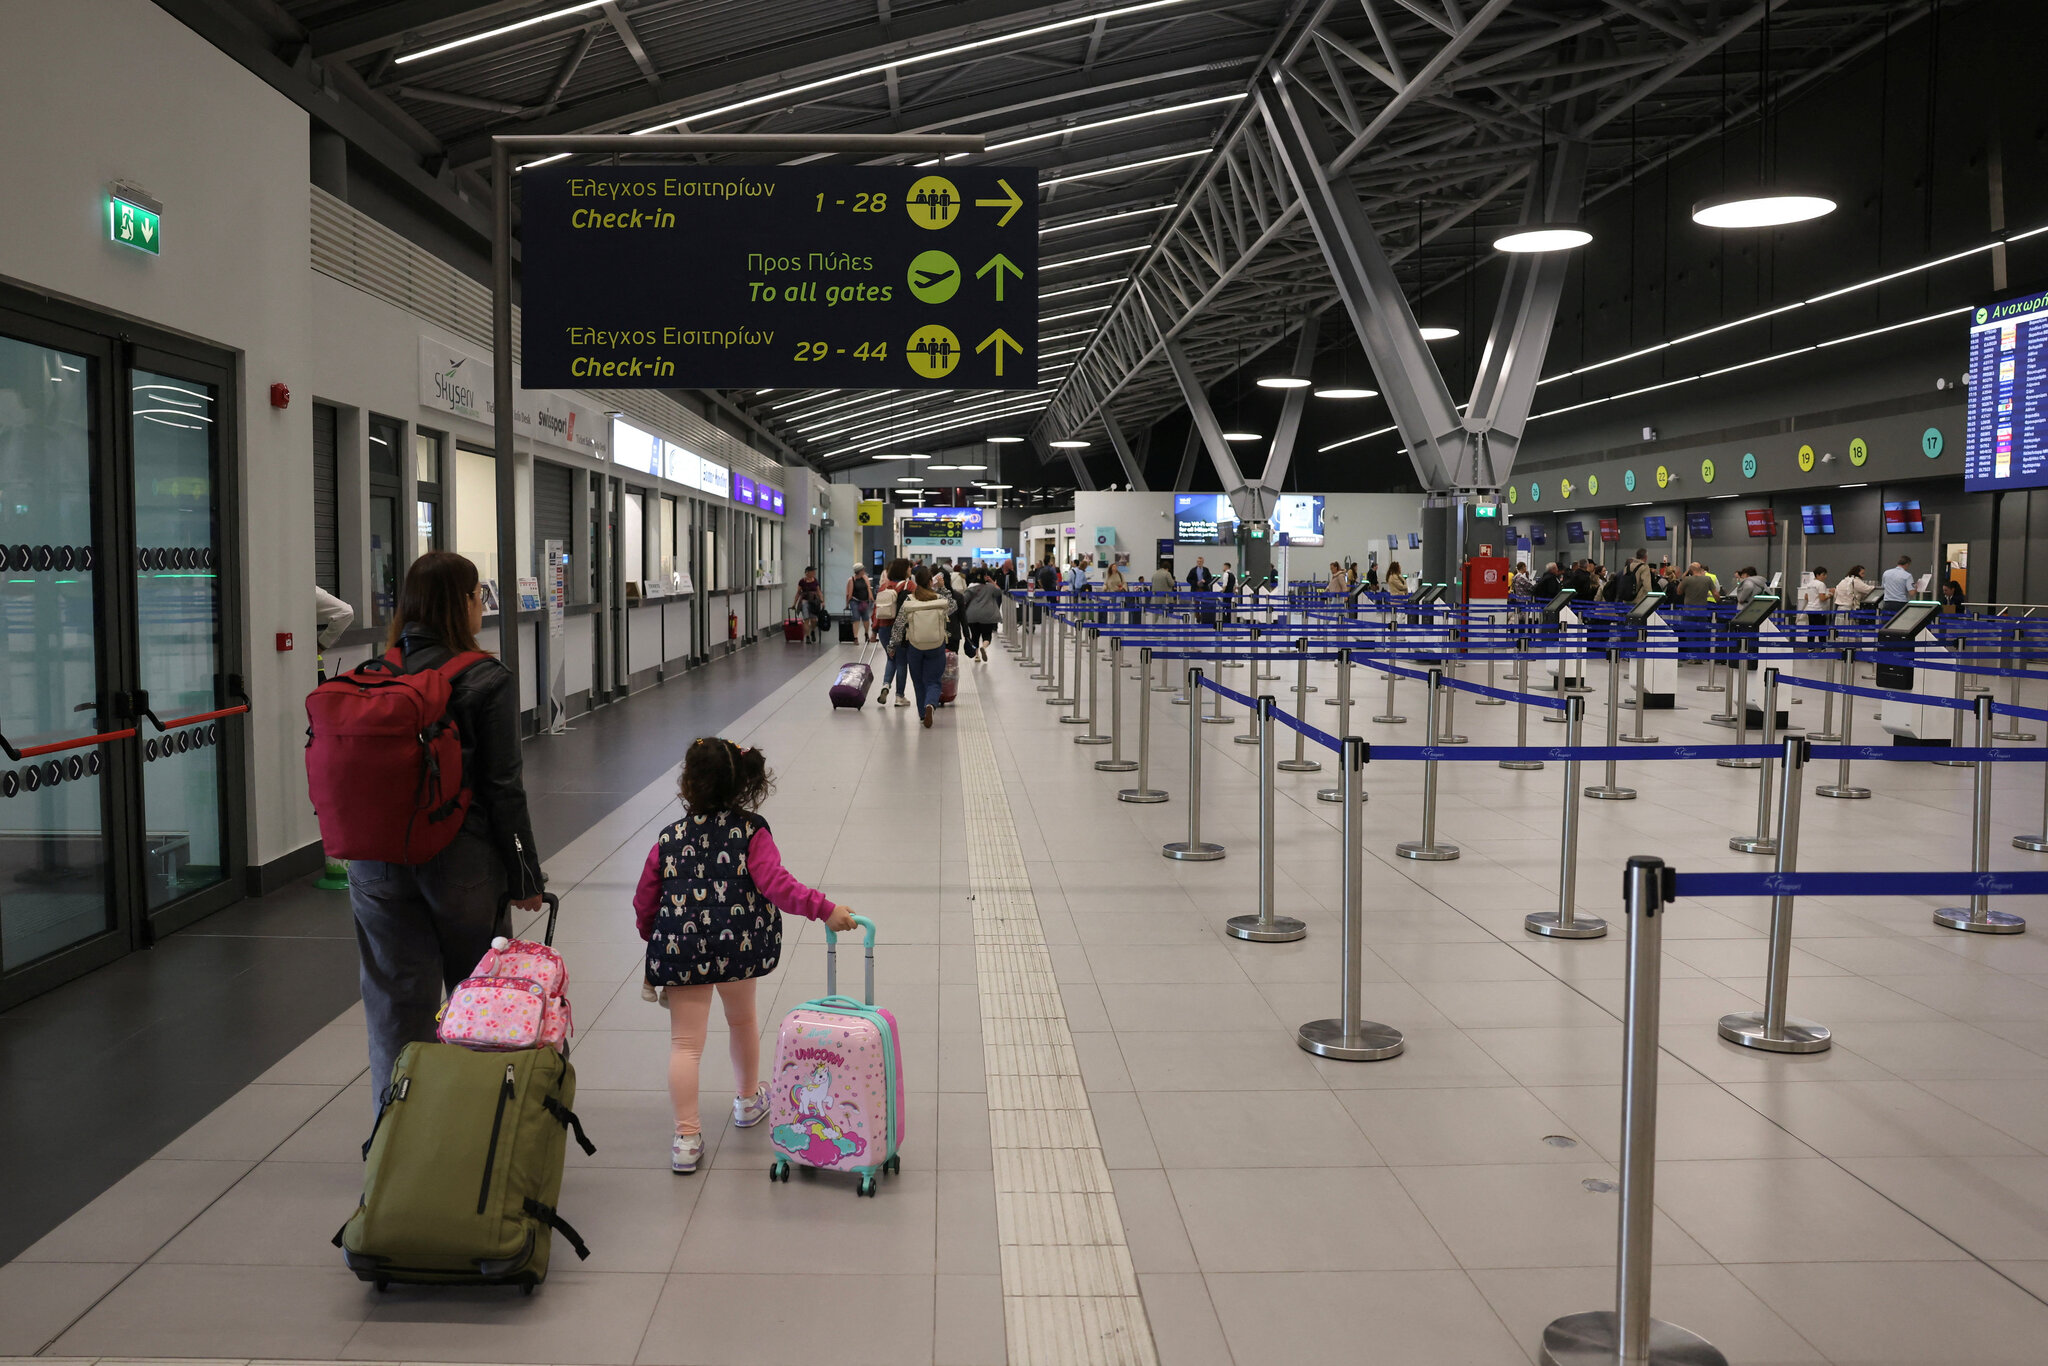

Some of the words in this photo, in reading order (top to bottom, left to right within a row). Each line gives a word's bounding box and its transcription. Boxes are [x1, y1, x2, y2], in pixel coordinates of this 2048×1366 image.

[567, 179, 656, 200] Έλεγχος
[664, 178, 775, 200] Εισιτηρίων
[815, 193, 824, 212] 1
[852, 193, 887, 212] 28
[572, 208, 675, 228] Check-in
[749, 254, 801, 275] Προς
[808, 252, 873, 271] Πύλες
[749, 283, 776, 302] To
[785, 282, 816, 301] all
[826, 283, 893, 306] gates
[566, 328, 656, 349] Έλεγχος
[664, 326, 774, 348] Εισιτηρίων
[793, 342, 828, 361] 29
[853, 342, 887, 361] 44
[572, 357, 675, 377] Check-in
[434, 372, 474, 410] Skyserv
[521, 412, 531, 425] Desk
[538, 408, 567, 437] swissport
[1853, 446, 1863, 458] 18
[1927, 437, 1938, 449] 17
[1744, 460, 1754, 471] 20
[1801, 453, 1810, 464] 19
[1626, 475, 1633, 486] 23
[1658, 472, 1666, 482] 22
[1704, 466, 1712, 477] 21
[795, 1047, 845, 1068] UNICORN
